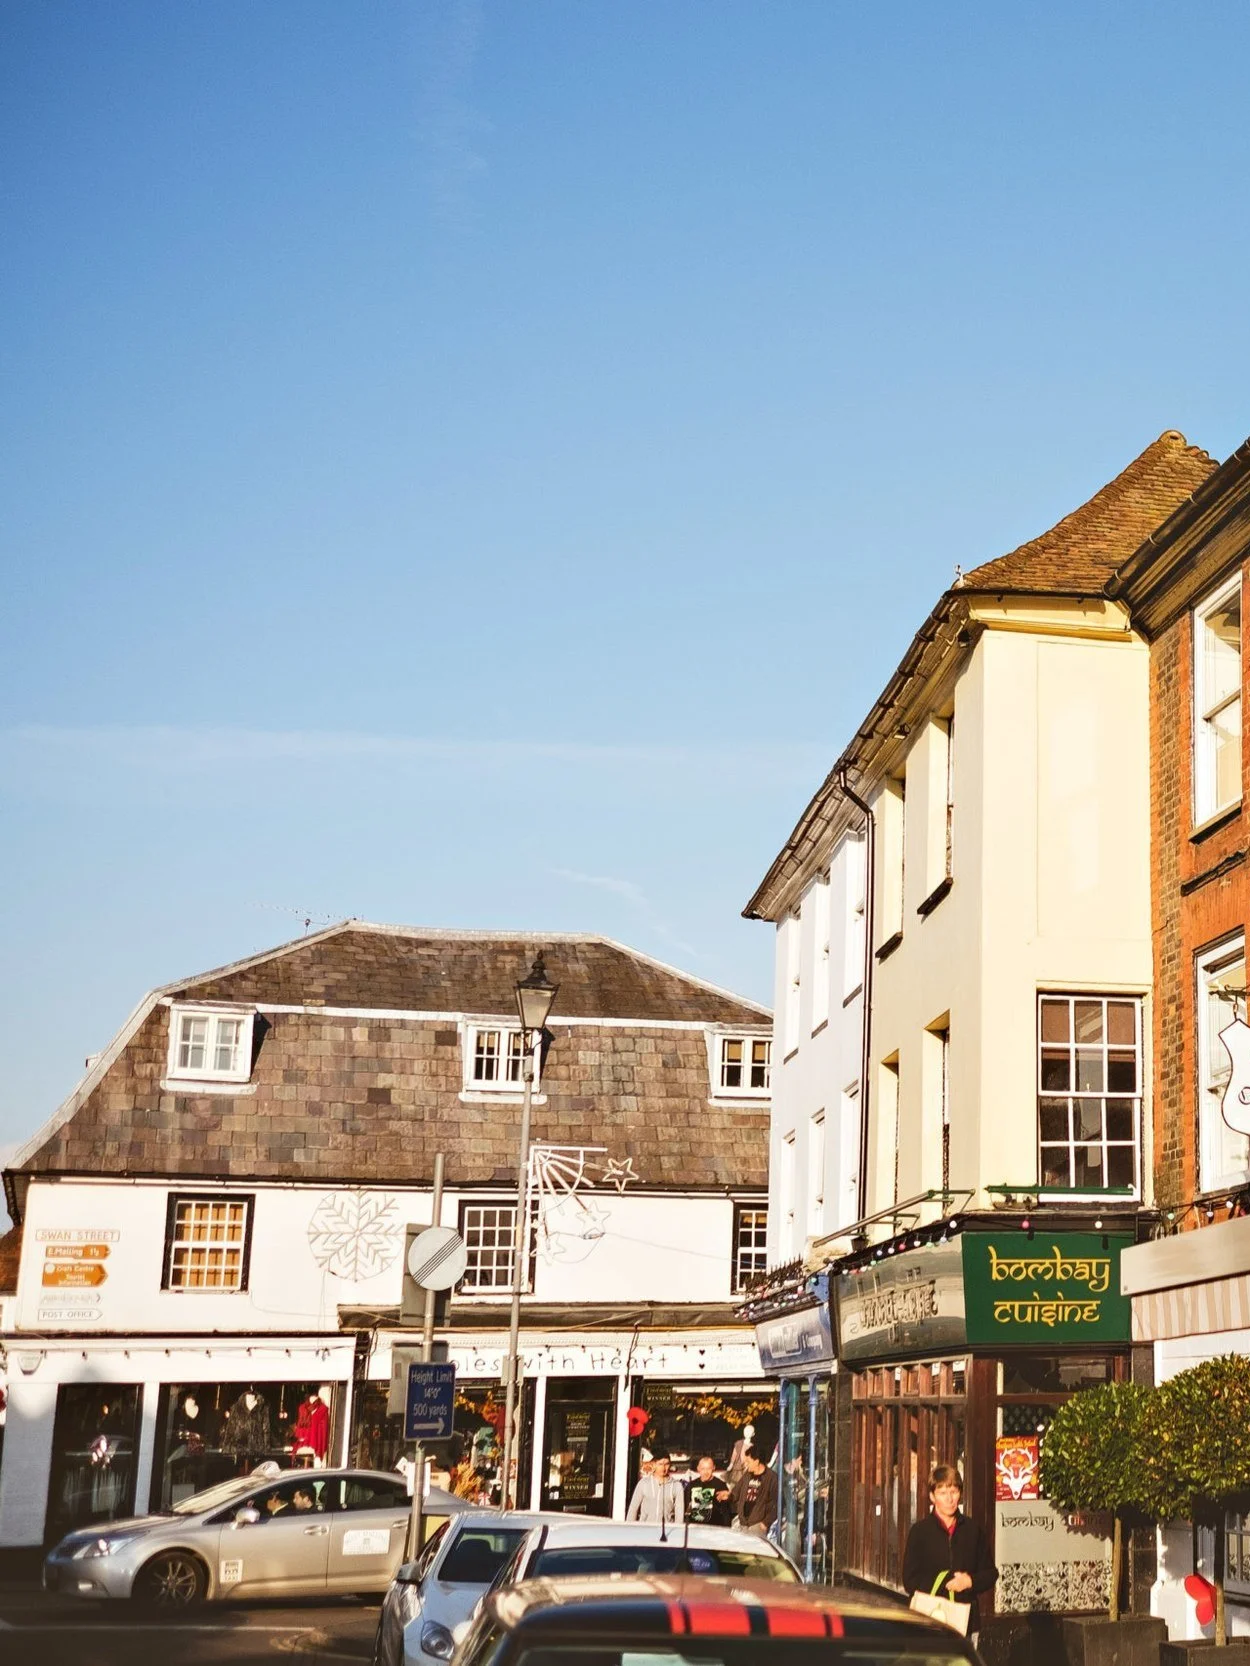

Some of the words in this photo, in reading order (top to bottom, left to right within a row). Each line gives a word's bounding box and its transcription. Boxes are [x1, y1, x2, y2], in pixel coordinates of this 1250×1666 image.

[41, 1231, 71, 1240] SWAN
[78, 1231, 115, 1240] STREET
[988, 1245, 1111, 1292] bombay
[42, 1311, 62, 1319] POST
[67, 1310, 93, 1319] OFFICE
[994, 1291, 1101, 1327] cuisine
[449, 1355, 499, 1371] oles
[591, 1353, 668, 1370] Heart
[411, 1370, 434, 1385] Height
[436, 1370, 453, 1383] Limit
[413, 1403, 428, 1416] 500
[428, 1403, 448, 1419] yards
[1001, 1511, 1055, 1532] bombay
